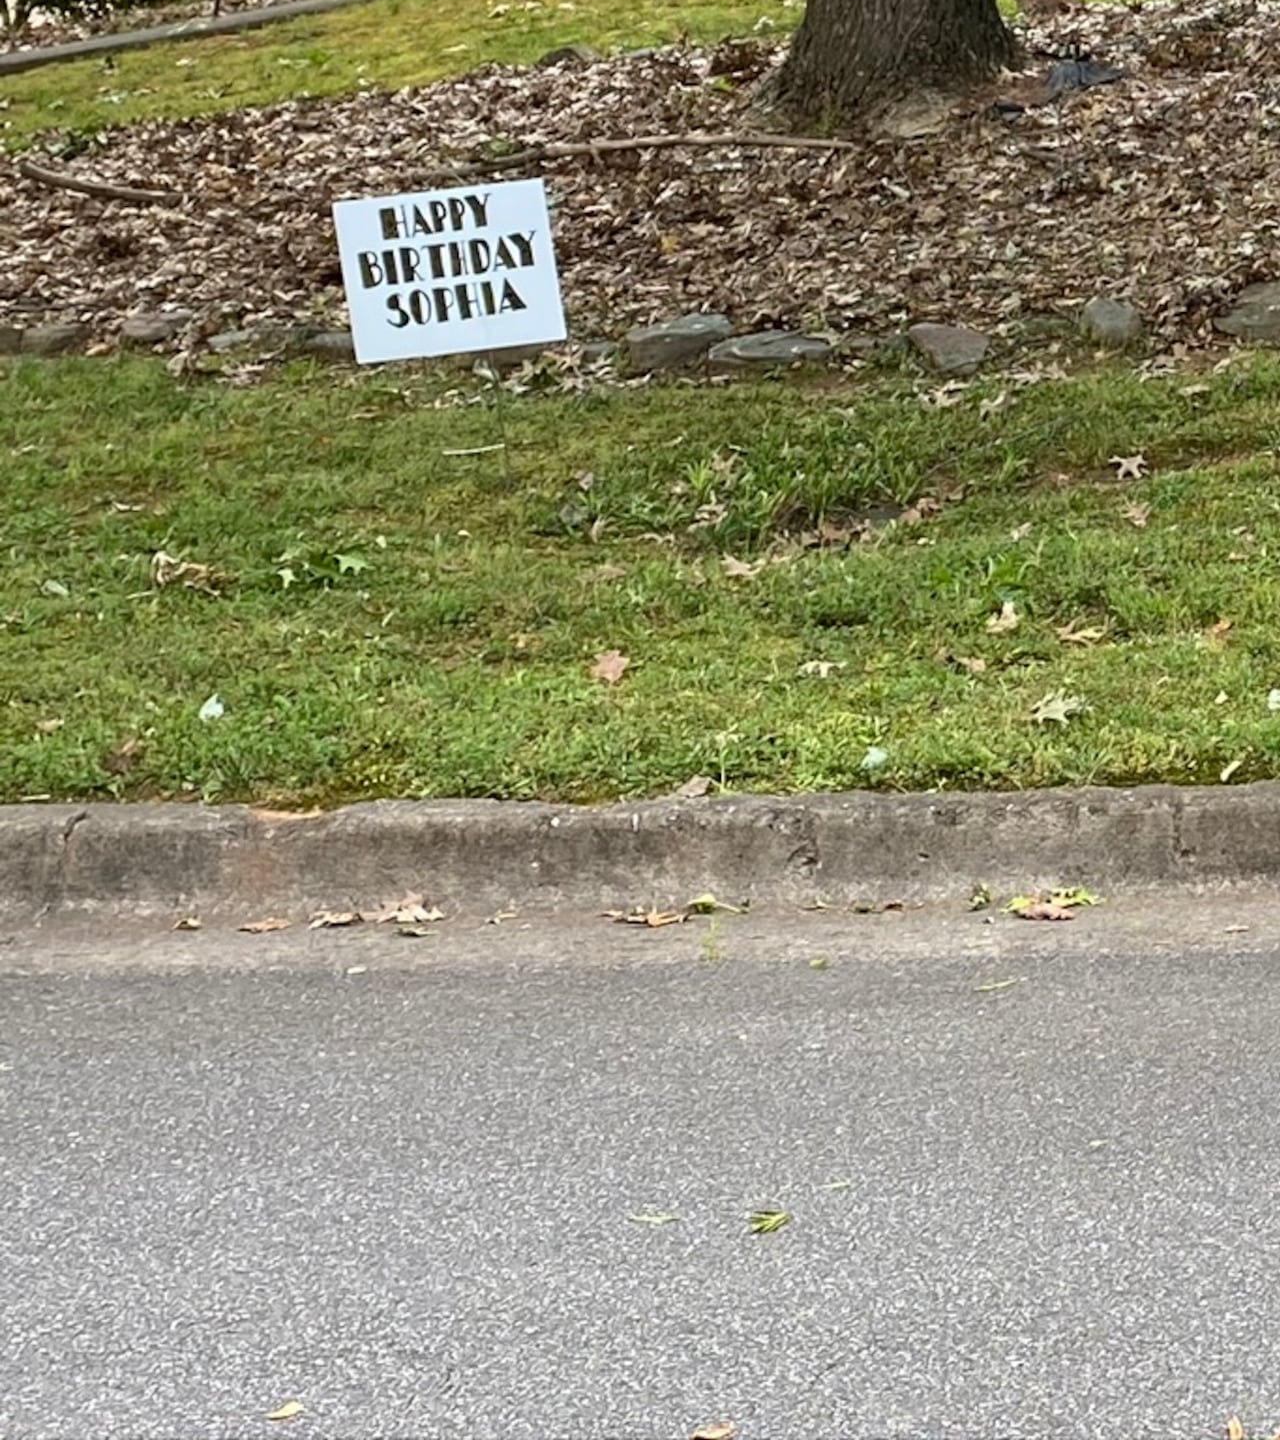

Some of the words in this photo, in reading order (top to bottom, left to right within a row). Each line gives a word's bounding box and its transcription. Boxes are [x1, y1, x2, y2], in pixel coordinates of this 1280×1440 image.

[378, 192, 492, 240] HAPPY
[357, 230, 537, 290] BIRTHDAY
[386, 278, 528, 329] SOPHIA
